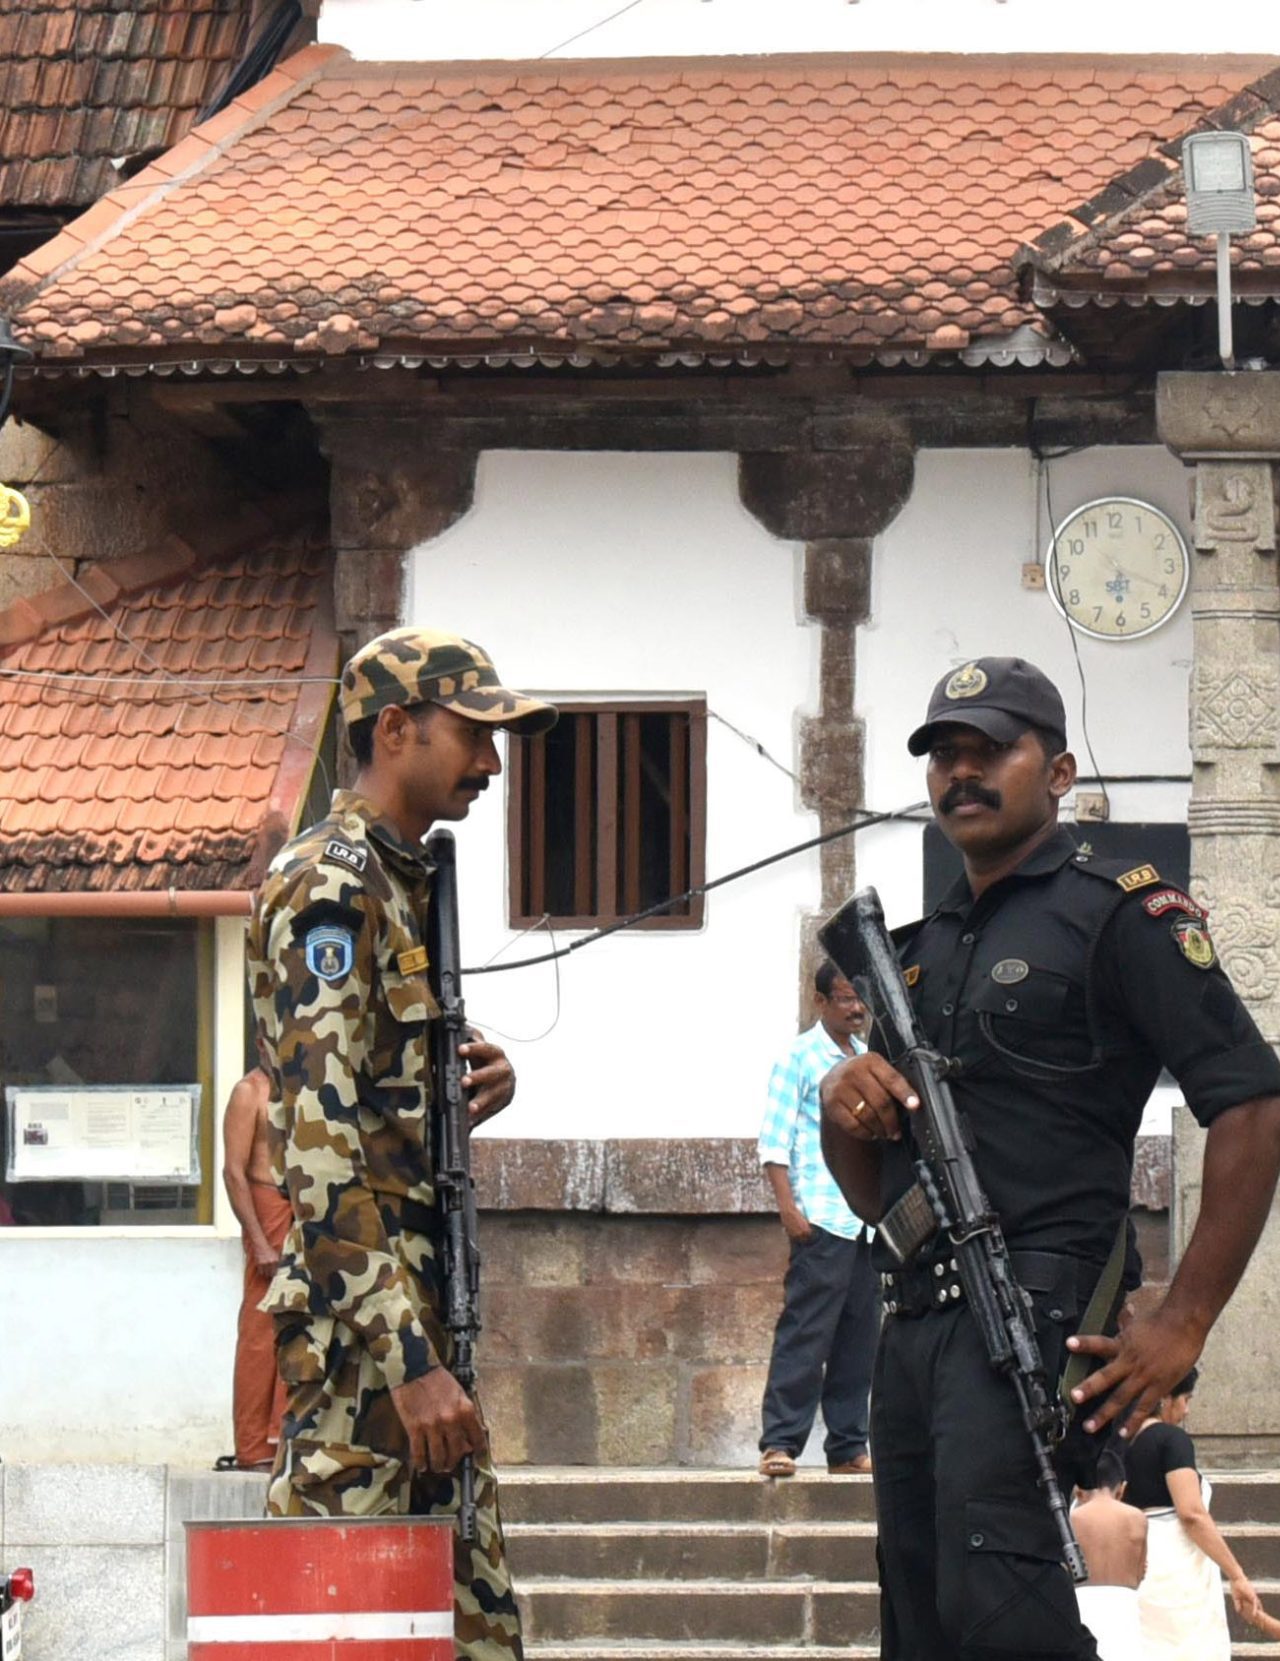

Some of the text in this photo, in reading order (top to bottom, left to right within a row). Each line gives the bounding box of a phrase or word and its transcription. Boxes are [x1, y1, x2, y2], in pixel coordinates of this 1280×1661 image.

[1106, 512, 1123, 529] 12
[1083, 521, 1098, 538] 11
[1067, 539, 1084, 556] 10
[1154, 533, 1165, 551] 2
[1060, 565, 1071, 581] 9
[1163, 558, 1176, 575] 3
[1069, 589, 1081, 606] 8
[1157, 584, 1168, 599] 4
[1093, 606, 1103, 623] 7
[1140, 602, 1151, 619] 5
[1115, 611, 1126, 628] 6
[1147, 893, 1203, 918] COMMANDO
